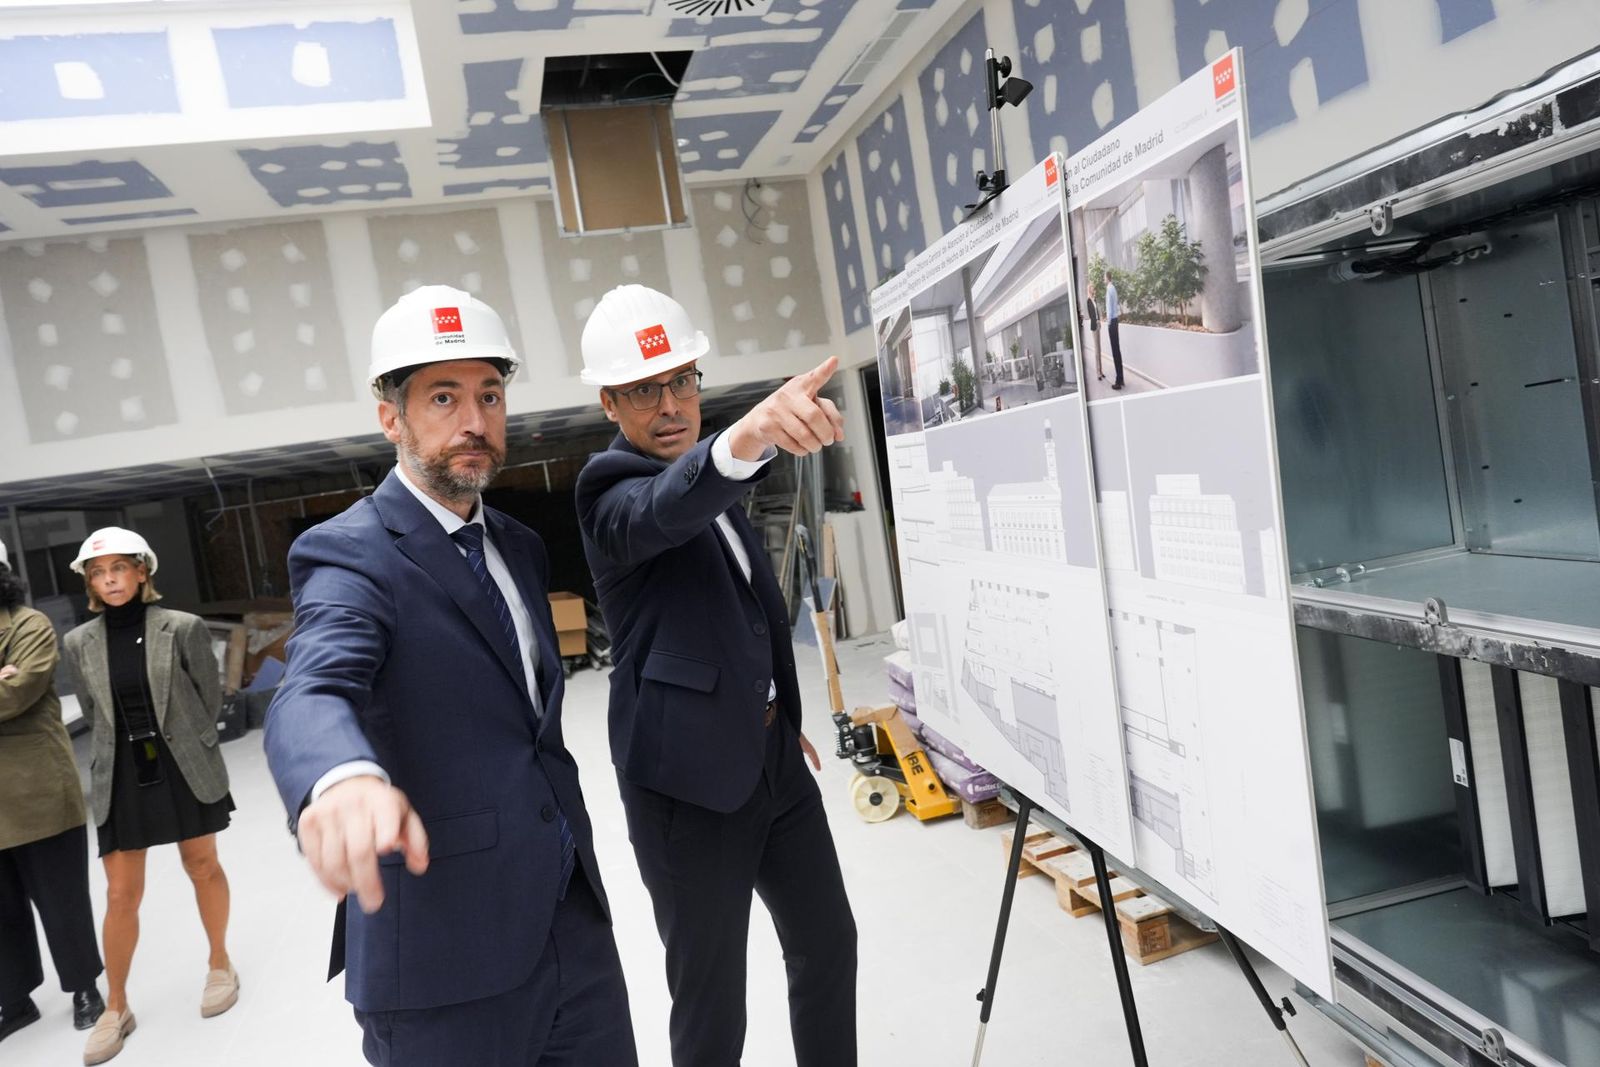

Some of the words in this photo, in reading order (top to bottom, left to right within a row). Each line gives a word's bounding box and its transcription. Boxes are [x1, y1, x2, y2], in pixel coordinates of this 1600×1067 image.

[1072, 184, 1079, 194] la
[1080, 155, 1121, 190] Comunidad
[1122, 150, 1133, 165] de
[1134, 129, 1164, 158] Madrid
[1073, 160, 1080, 175] al
[1081, 139, 1120, 170] Ciudadano
[969, 211, 993, 234] Ciudadano
[969, 225, 994, 250] Comunidad
[994, 222, 1001, 232] de
[1001, 208, 1018, 227] Madrid
